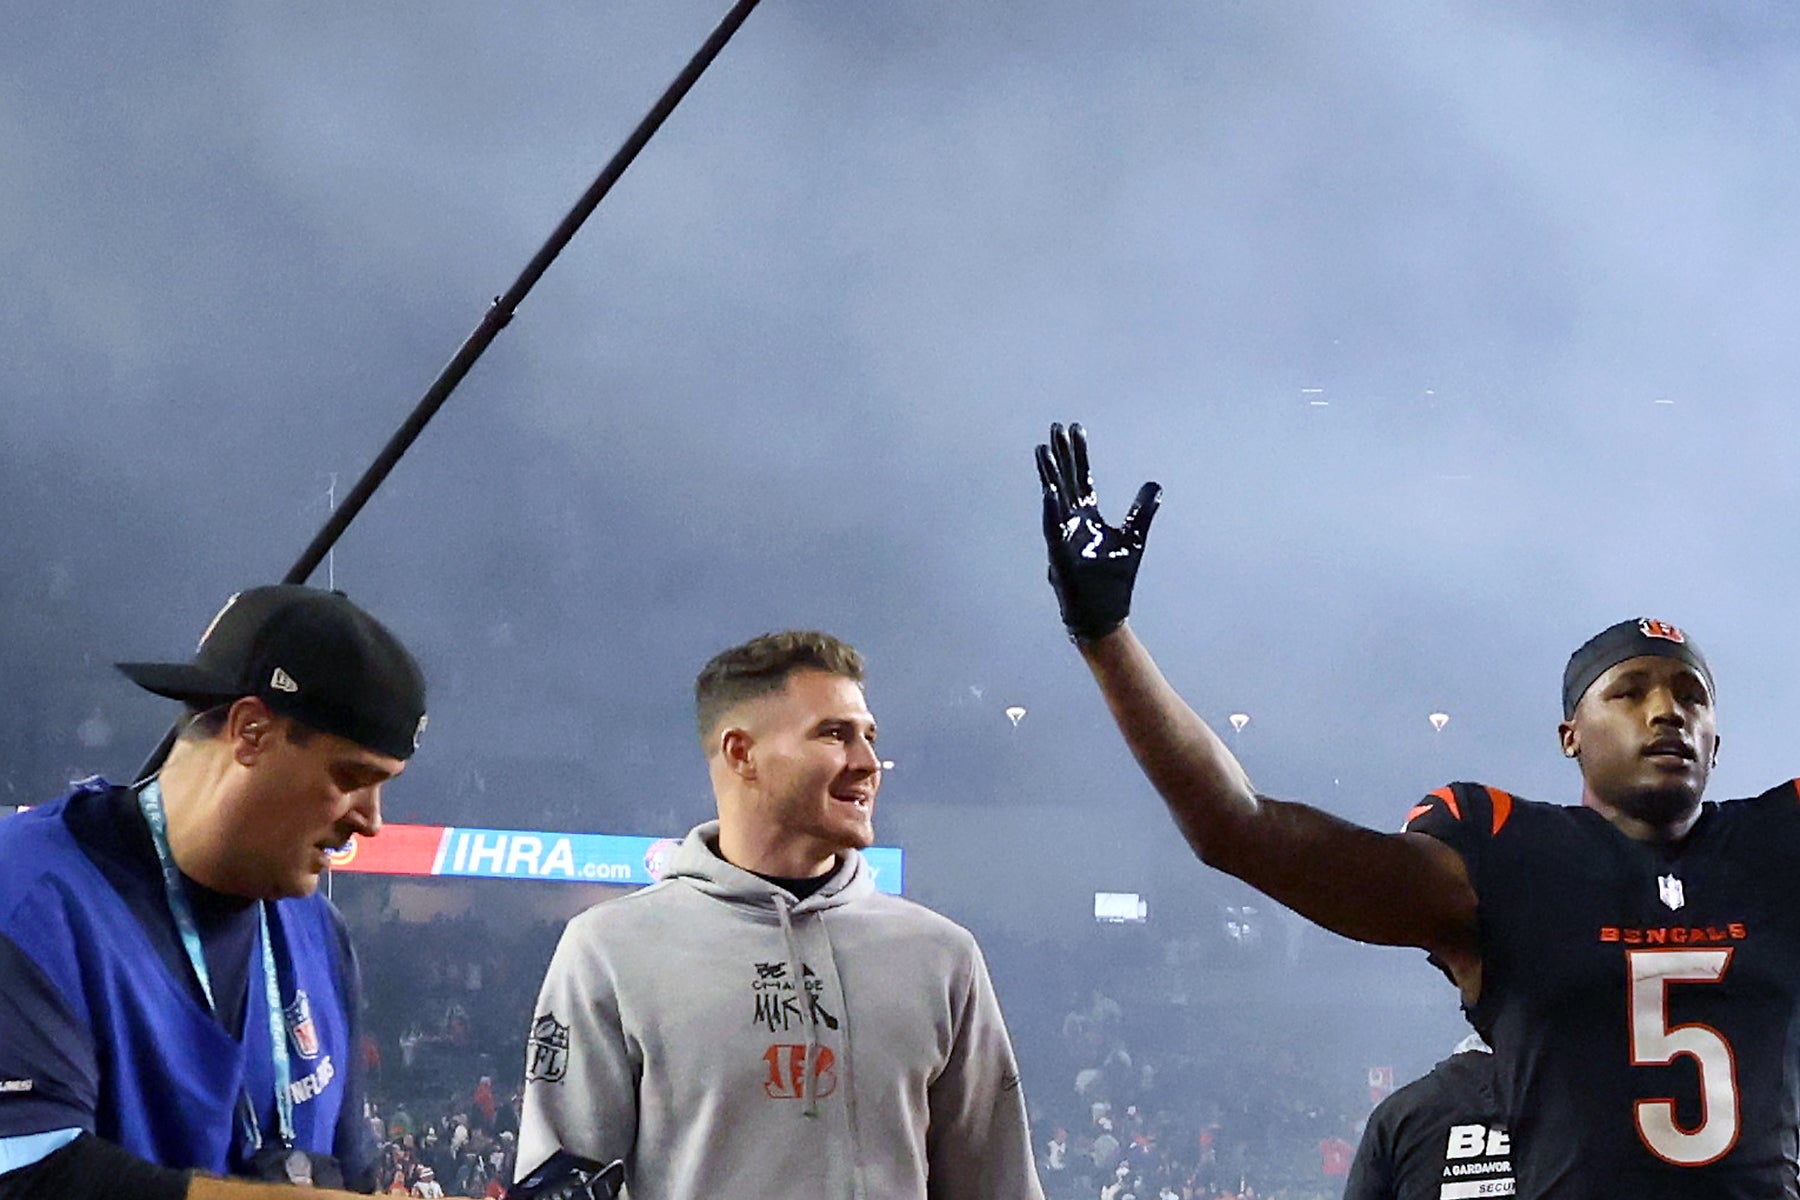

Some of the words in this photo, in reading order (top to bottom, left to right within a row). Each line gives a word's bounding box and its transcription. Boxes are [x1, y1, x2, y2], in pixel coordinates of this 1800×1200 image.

[1600, 922, 1747, 944] BENGALS
[1624, 946, 1741, 1168] 5
[1443, 1166, 1452, 1177] A
[1452, 1161, 1512, 1176] GARDAWOR
